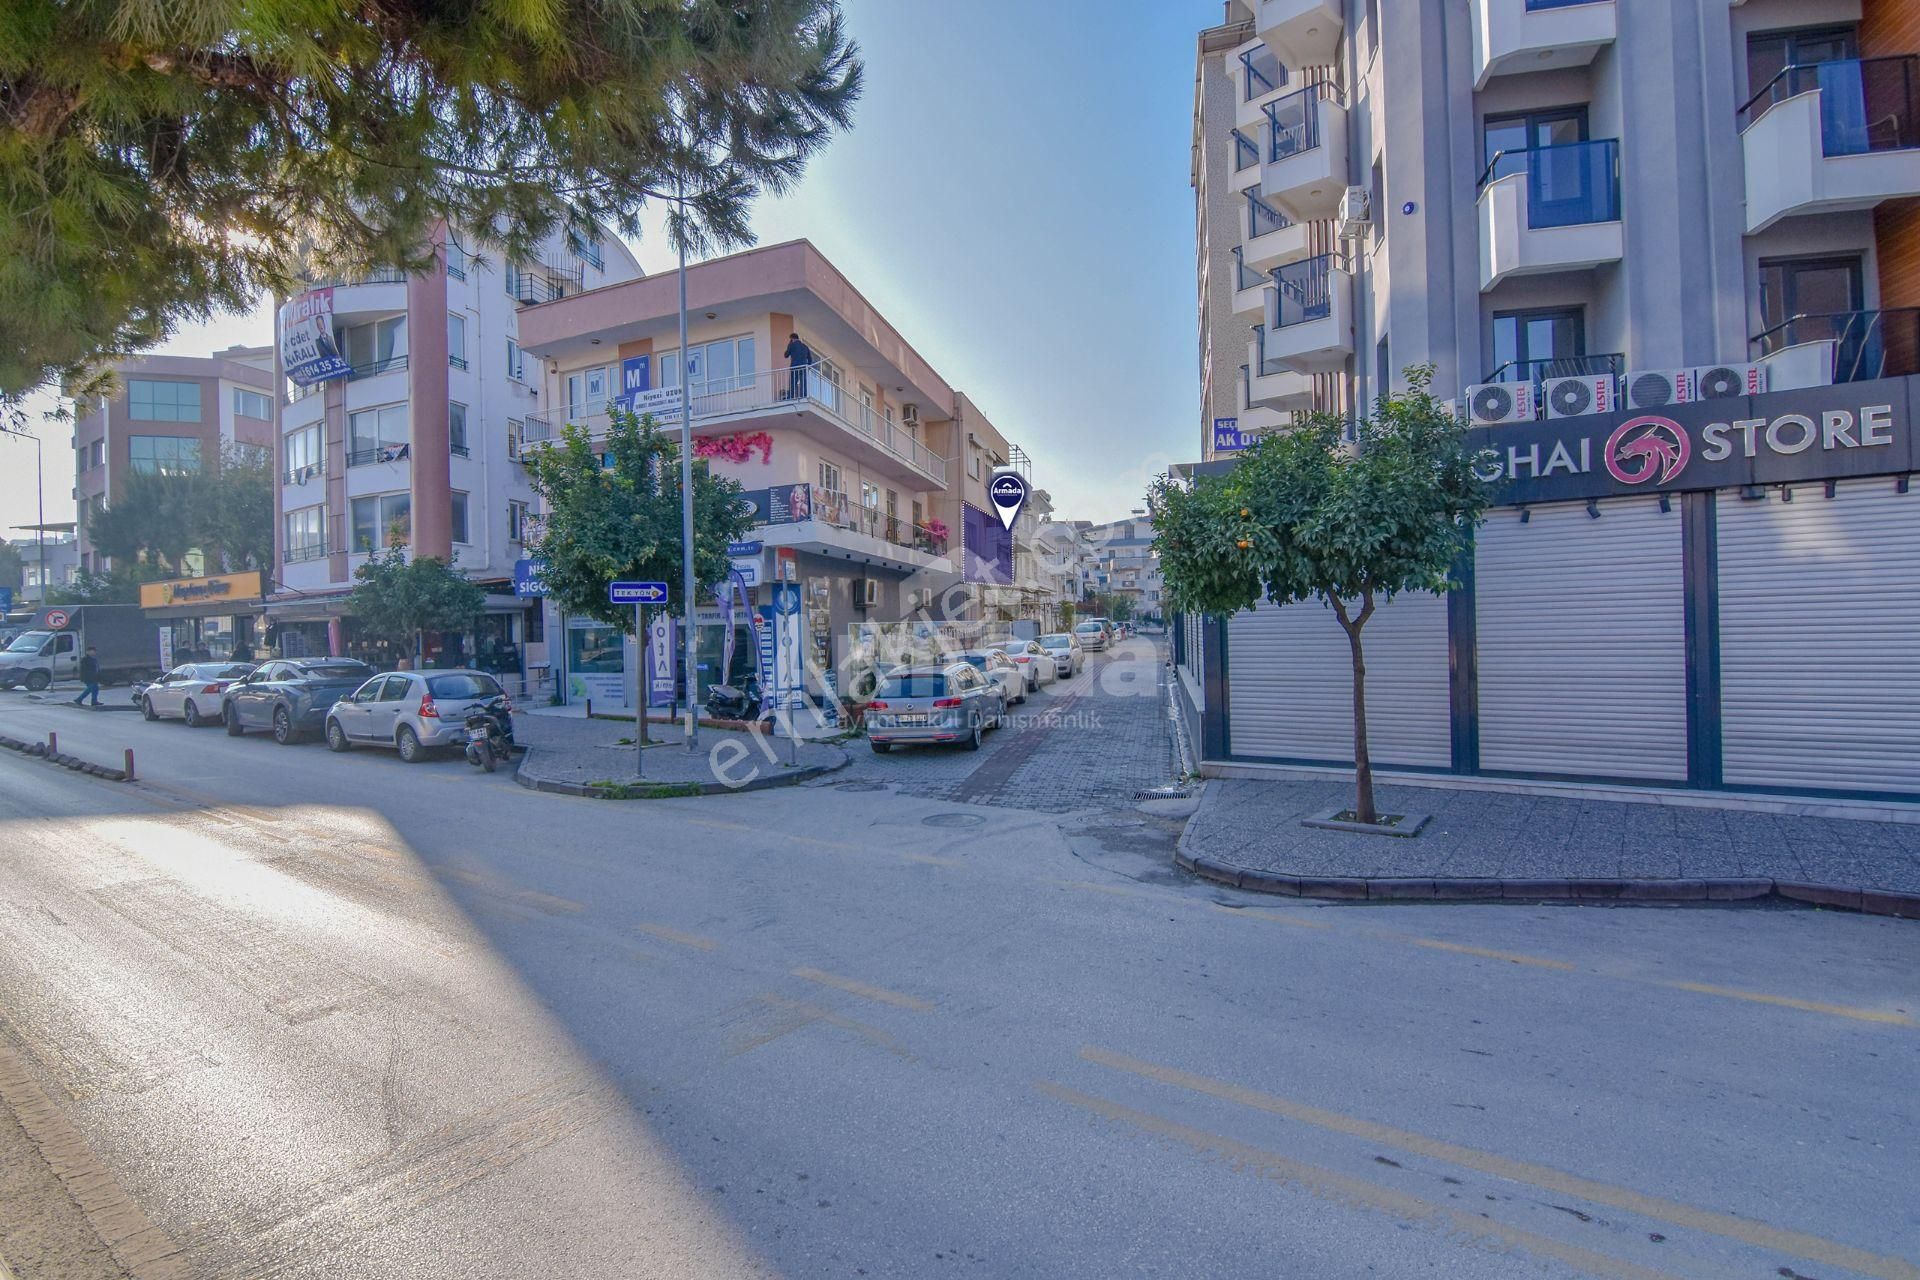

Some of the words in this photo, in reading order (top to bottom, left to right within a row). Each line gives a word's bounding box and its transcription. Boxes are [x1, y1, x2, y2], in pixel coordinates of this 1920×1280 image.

[627, 369, 640, 389] M
[1748, 367, 1758, 395] ESTEL
[1516, 384, 1526, 419] VESTEL
[1595, 378, 1606, 412] VESTEL
[1216, 433, 1237, 447] AK
[1702, 404, 1893, 461] STORE
